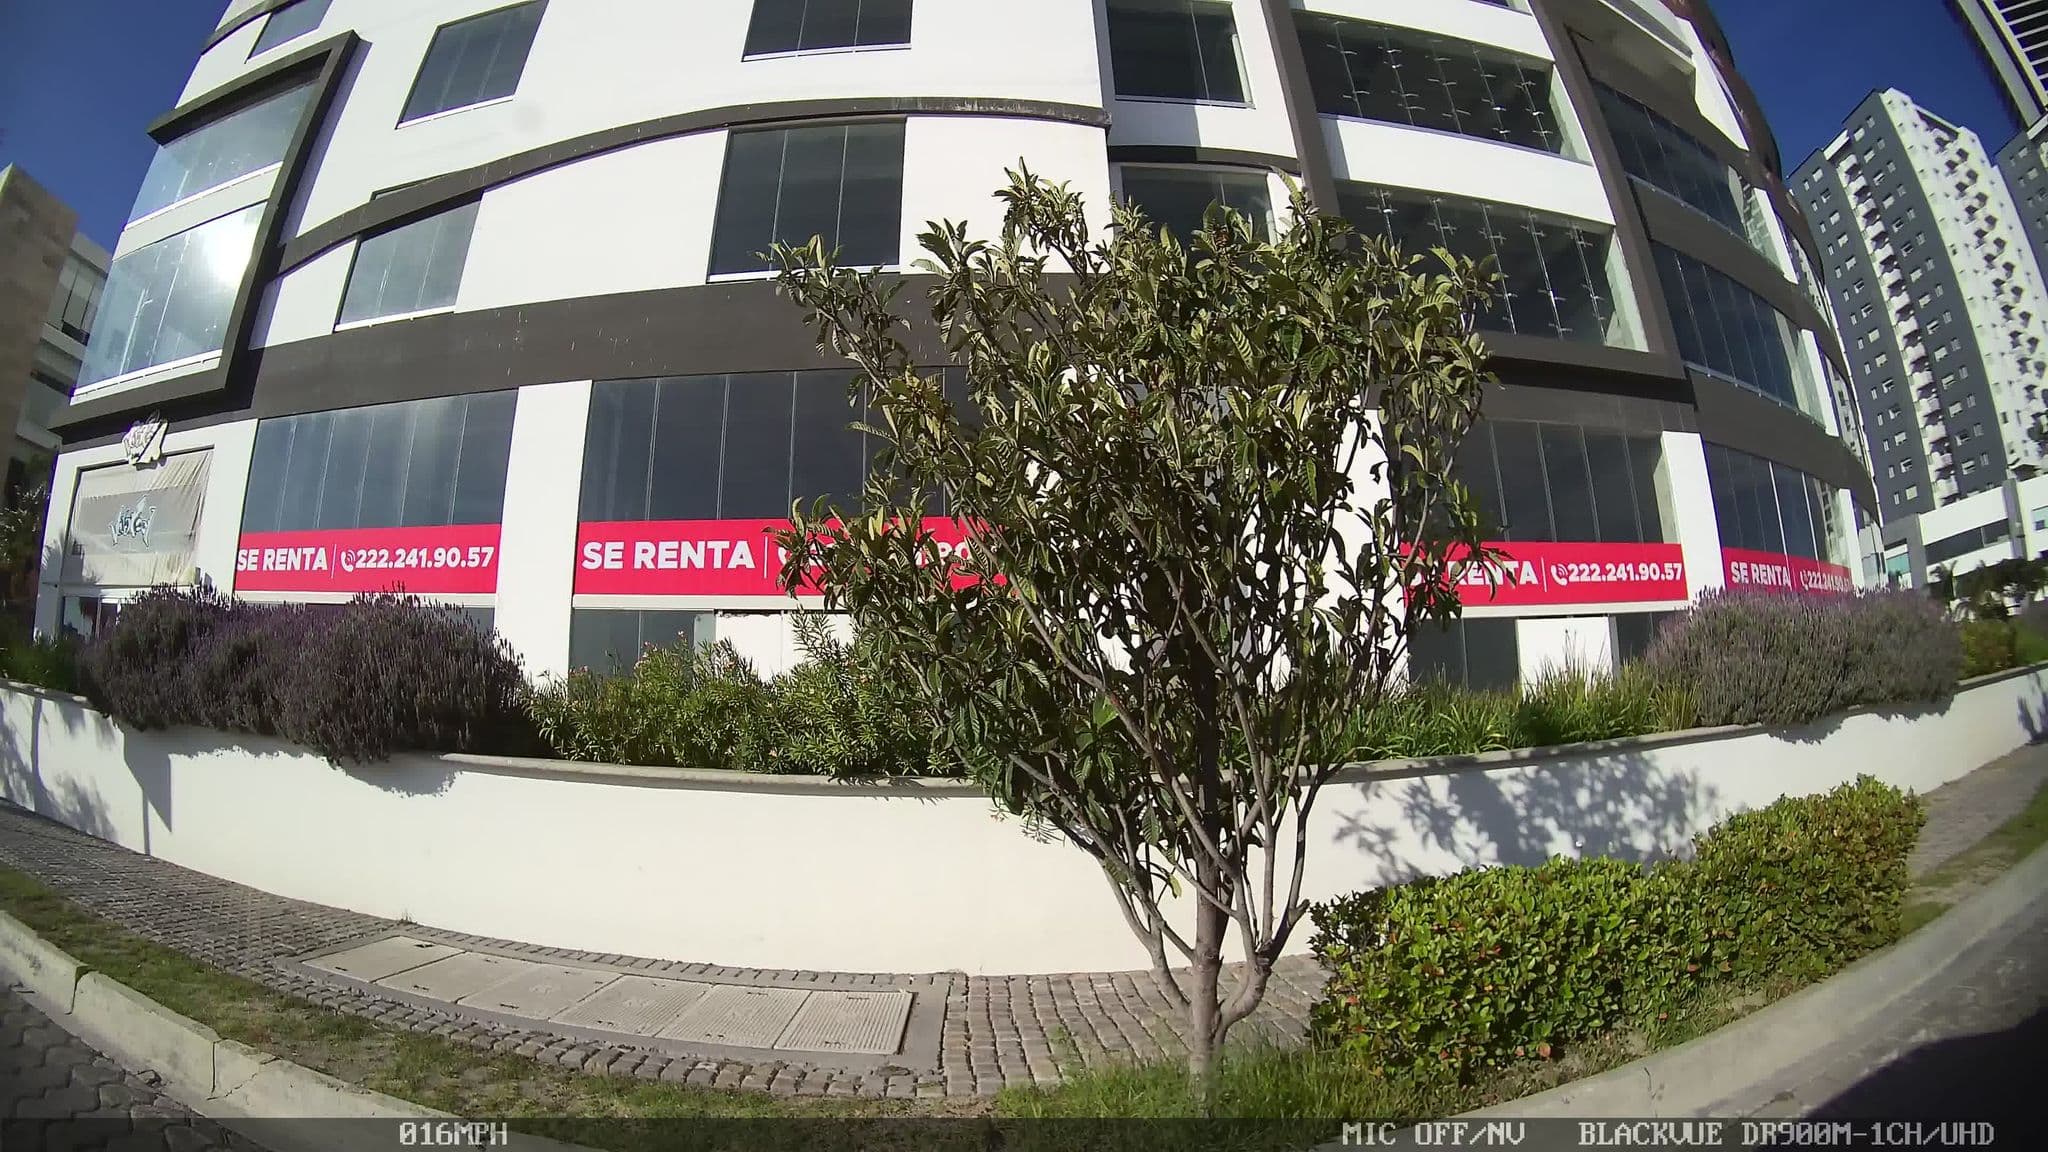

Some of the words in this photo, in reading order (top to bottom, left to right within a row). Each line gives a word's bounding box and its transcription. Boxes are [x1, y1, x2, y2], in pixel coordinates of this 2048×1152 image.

[237, 548, 259, 572] SE
[262, 547, 328, 571] RENTA
[355, 546, 494, 569] 222.241.90.57
[581, 540, 624, 570] SE
[633, 540, 756, 570] RENTA
[1567, 563, 1683, 583] 222.241.90.57
[1730, 561, 1749, 584] SE
[1750, 563, 1792, 587] RENTA
